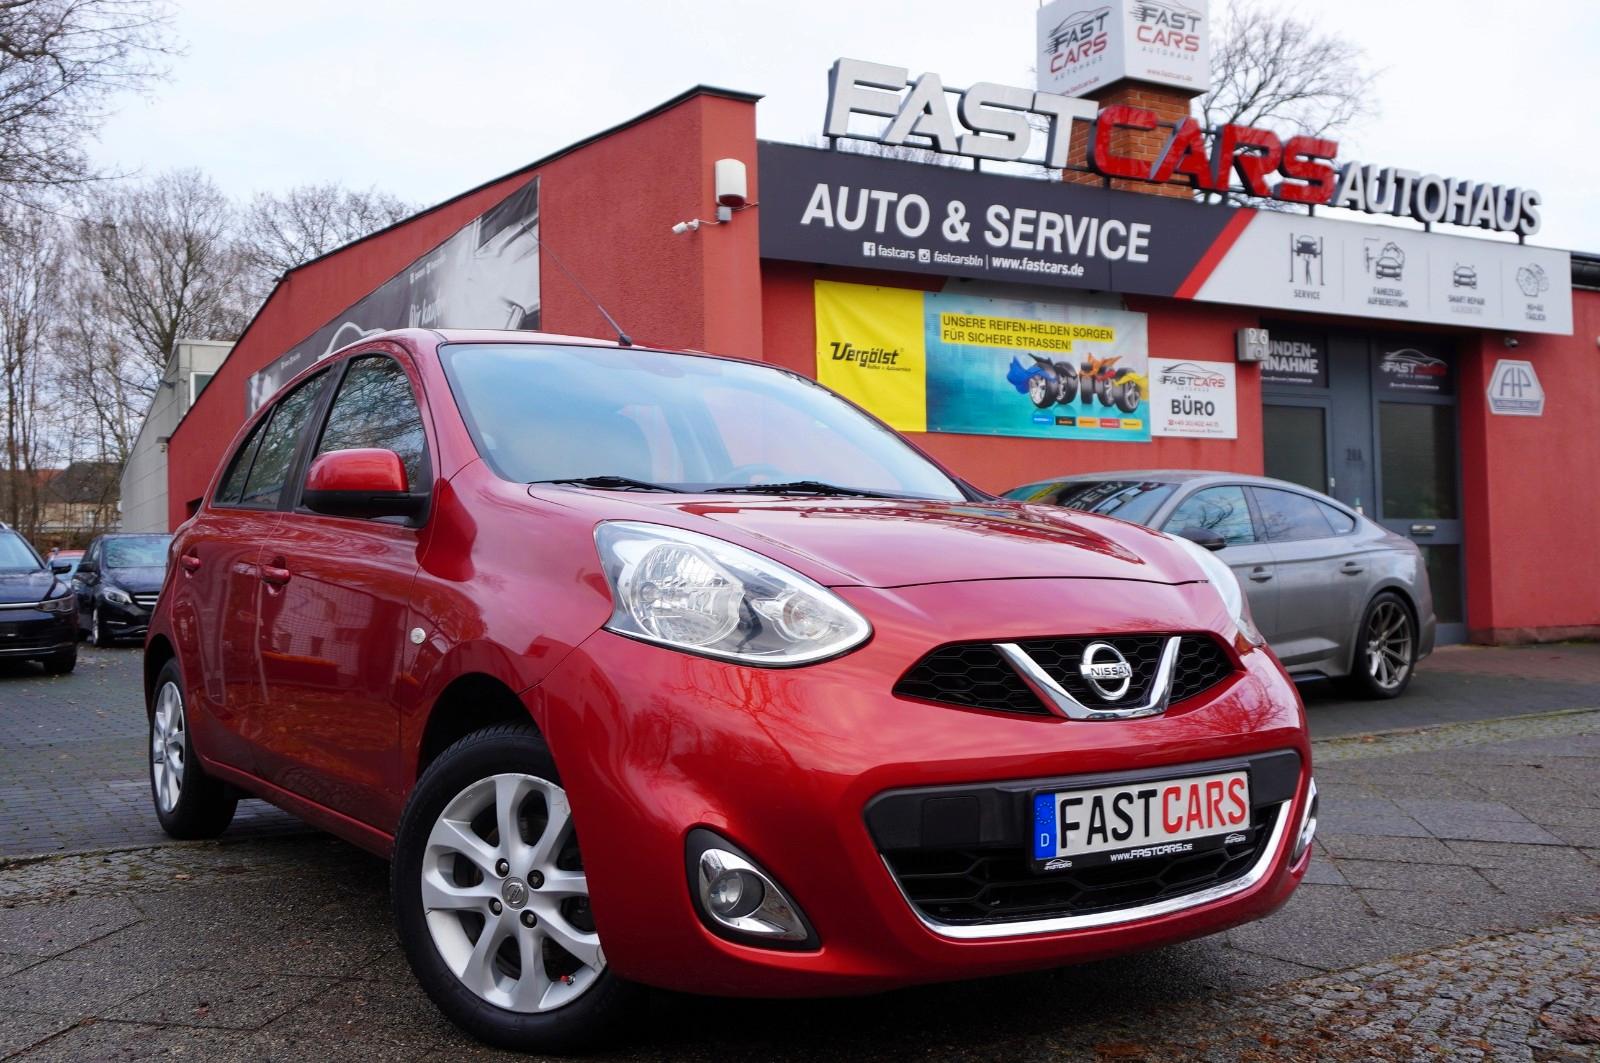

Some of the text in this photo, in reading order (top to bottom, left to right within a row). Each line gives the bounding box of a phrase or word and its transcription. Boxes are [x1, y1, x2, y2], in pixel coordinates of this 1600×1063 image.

[1143, 5, 1202, 32] FAST
[1050, 11, 1110, 53] FAST
[1137, 25, 1200, 52] CARS
[1051, 32, 1108, 74] CARS
[1334, 160, 1541, 235] AUTOHAUS
[801, 183, 1152, 263] AUTO & SERVICE
[878, 244, 916, 260] fastcars
[992, 256, 1085, 277] www.fastcars.de
[1294, 289, 1320, 300] SERVICE
[943, 316, 1113, 340] UNSERE REIFEN-HELDEN SORGEN
[943, 330, 1071, 350] FÜR SICHERE STRASSEN!
[1248, 328, 1268, 344] 26
[830, 342, 899, 367] Vergölst
[1268, 340, 1317, 357] UNDEN-
[1260, 356, 1319, 373] NNAHME
[1171, 394, 1215, 416] BÜRO
[1091, 666, 1130, 676] NISSAN
[1040, 833, 1050, 847] D
